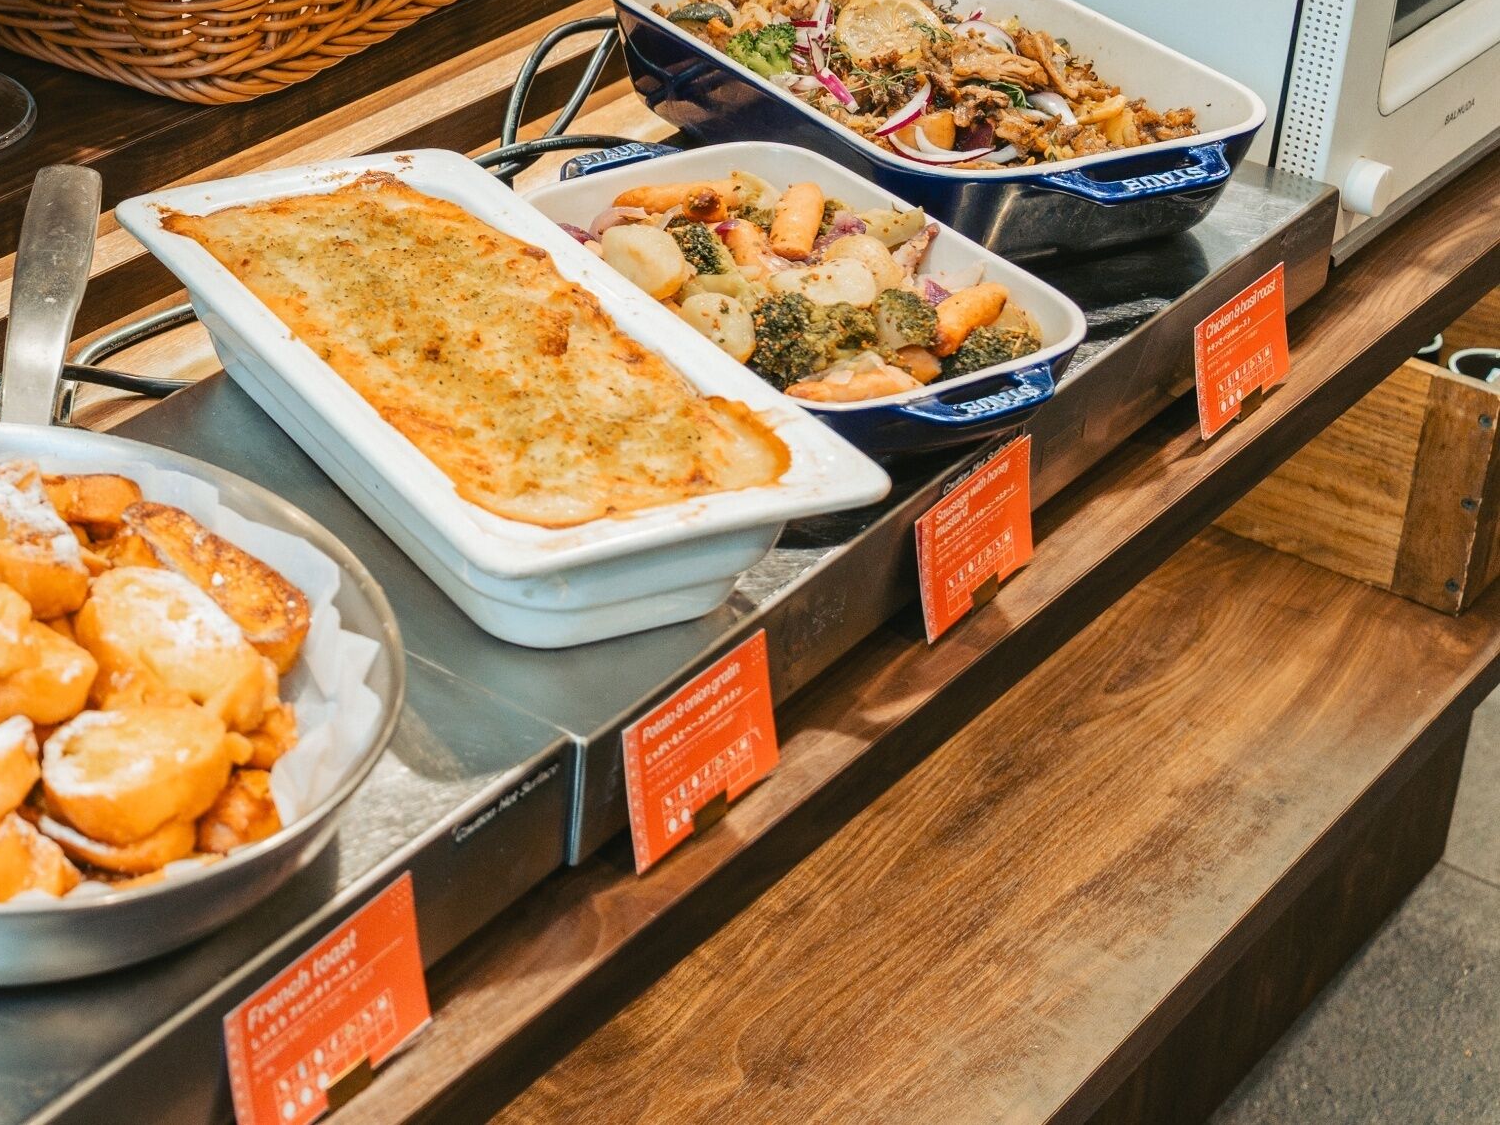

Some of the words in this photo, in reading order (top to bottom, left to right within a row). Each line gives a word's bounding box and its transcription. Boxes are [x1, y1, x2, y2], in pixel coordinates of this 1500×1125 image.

[1444, 97, 1476, 126] BALMUDA
[1122, 164, 1209, 193] STAUB
[1206, 308, 1235, 340] Chicken
[960, 384, 1042, 415] STAUB
